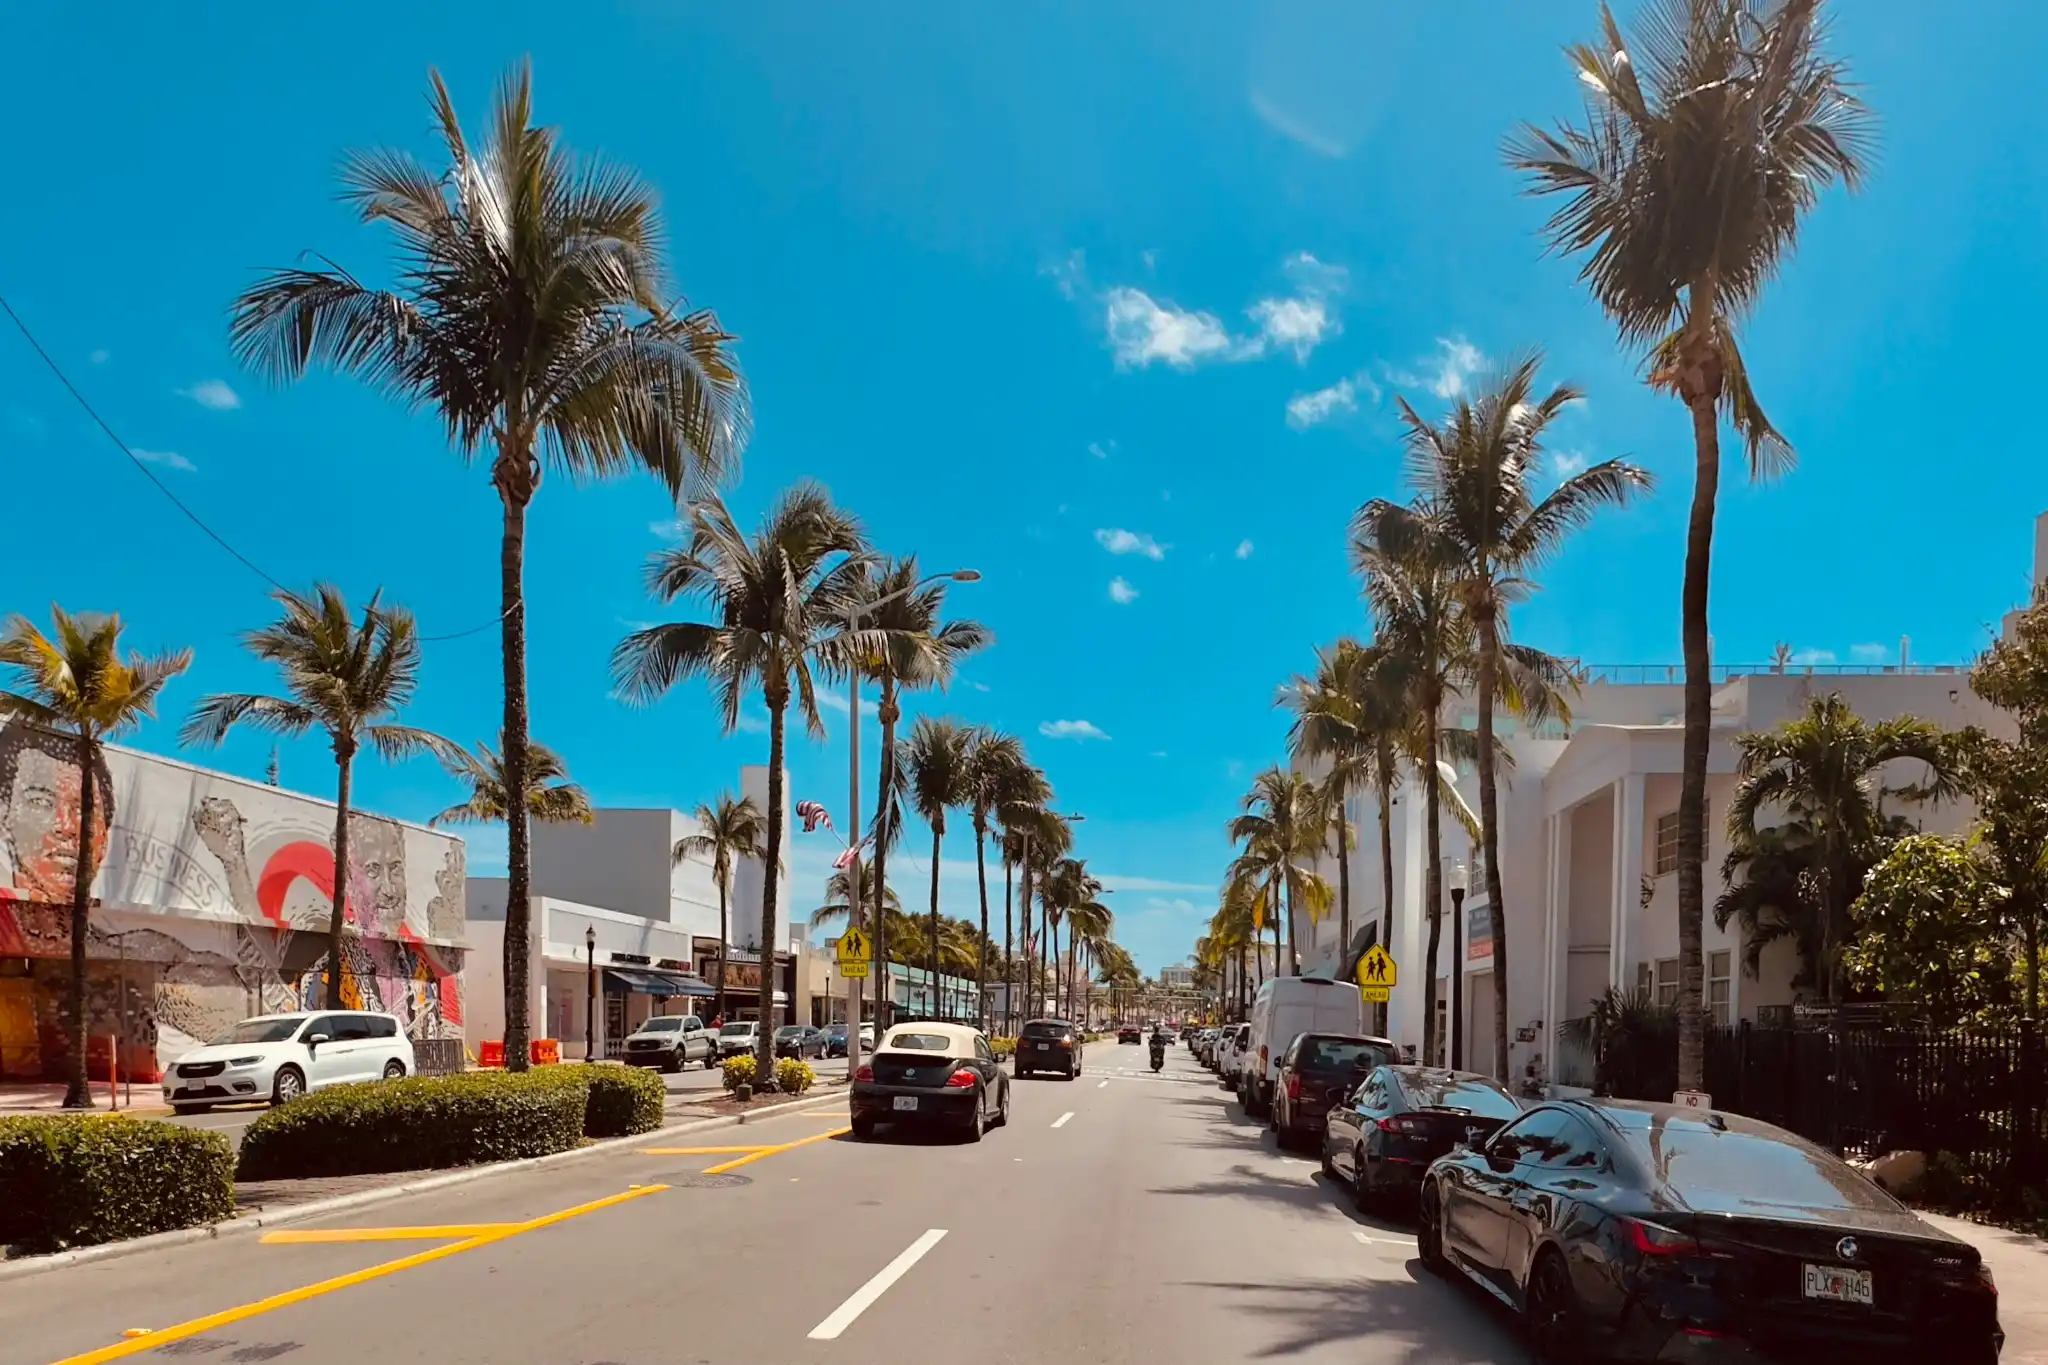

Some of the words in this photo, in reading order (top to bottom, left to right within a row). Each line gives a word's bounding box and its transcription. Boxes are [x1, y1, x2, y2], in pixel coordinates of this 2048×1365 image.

[125, 835, 216, 907] BUSINESS
[844, 965, 866, 974] AHEAD
[1686, 1096, 1698, 1108] NO
[1807, 1272, 1829, 1292] PLX
